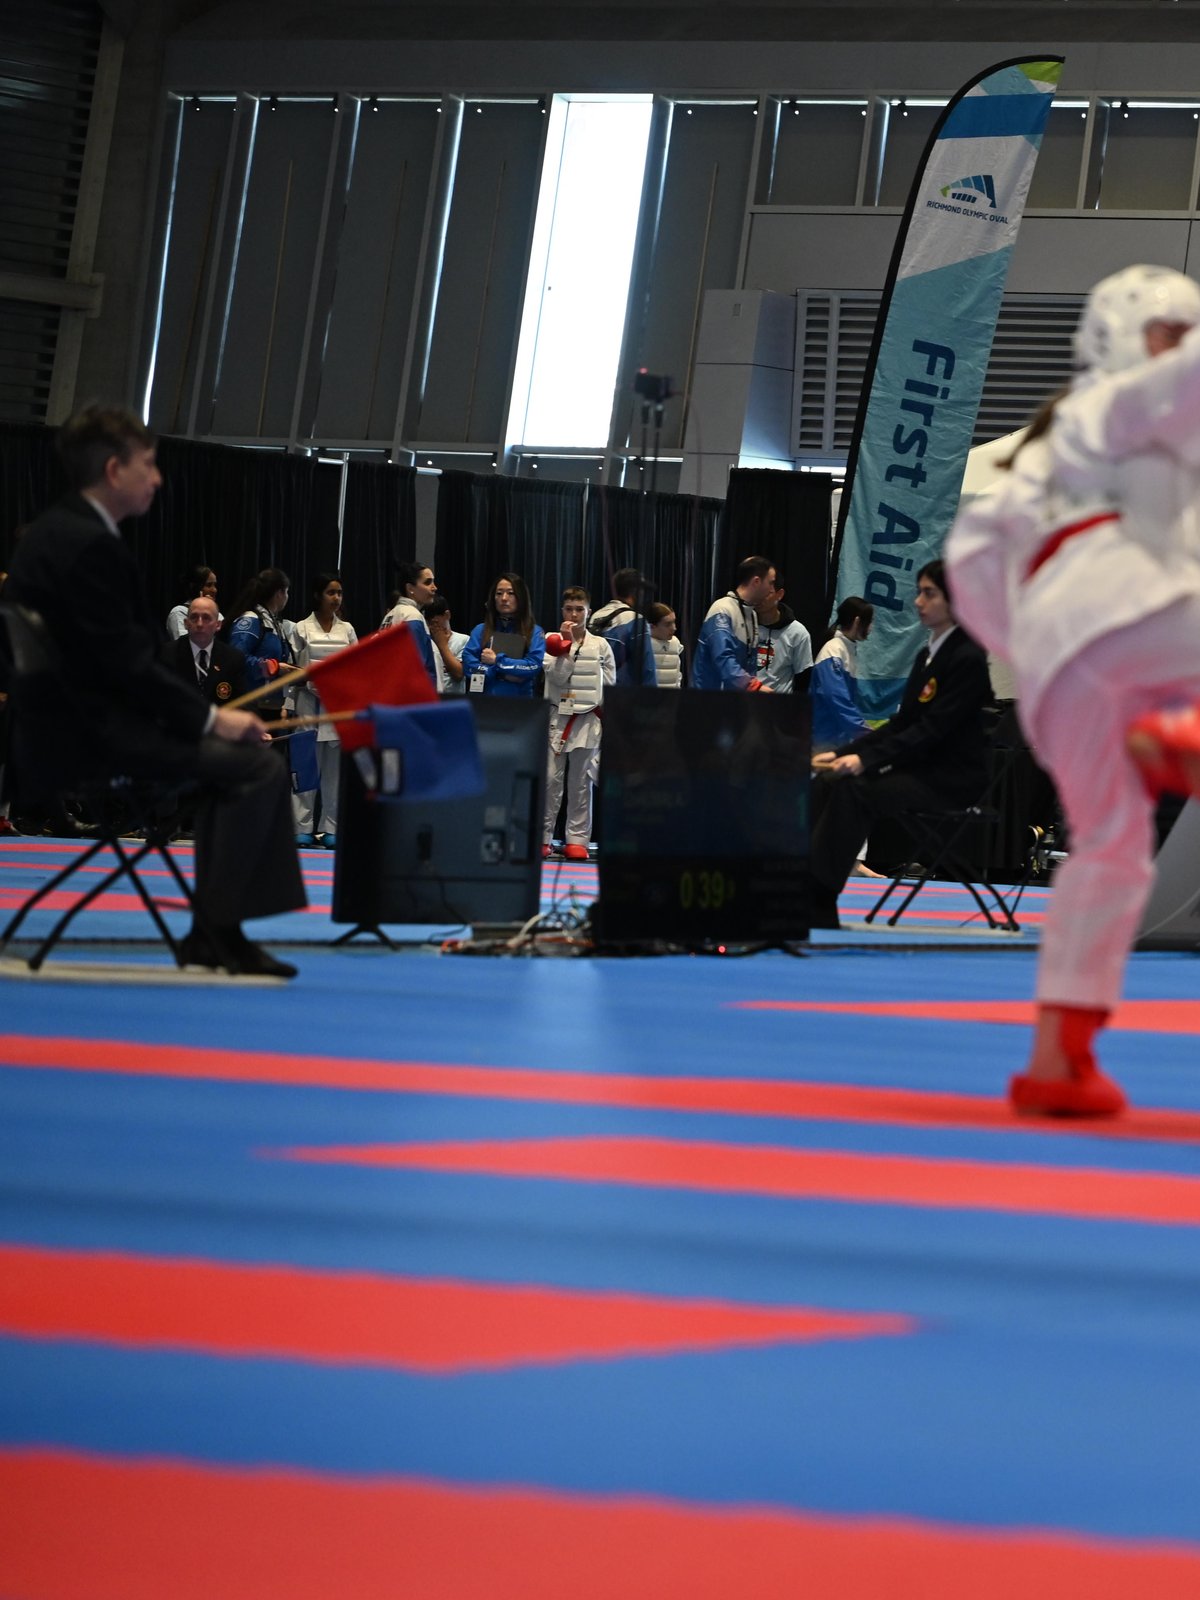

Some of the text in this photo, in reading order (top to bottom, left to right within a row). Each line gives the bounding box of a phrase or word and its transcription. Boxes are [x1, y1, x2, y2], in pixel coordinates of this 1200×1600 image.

[926, 200, 1009, 225] RICHMOND OLYMPIC OVAL
[864, 339, 956, 612] First Aid
